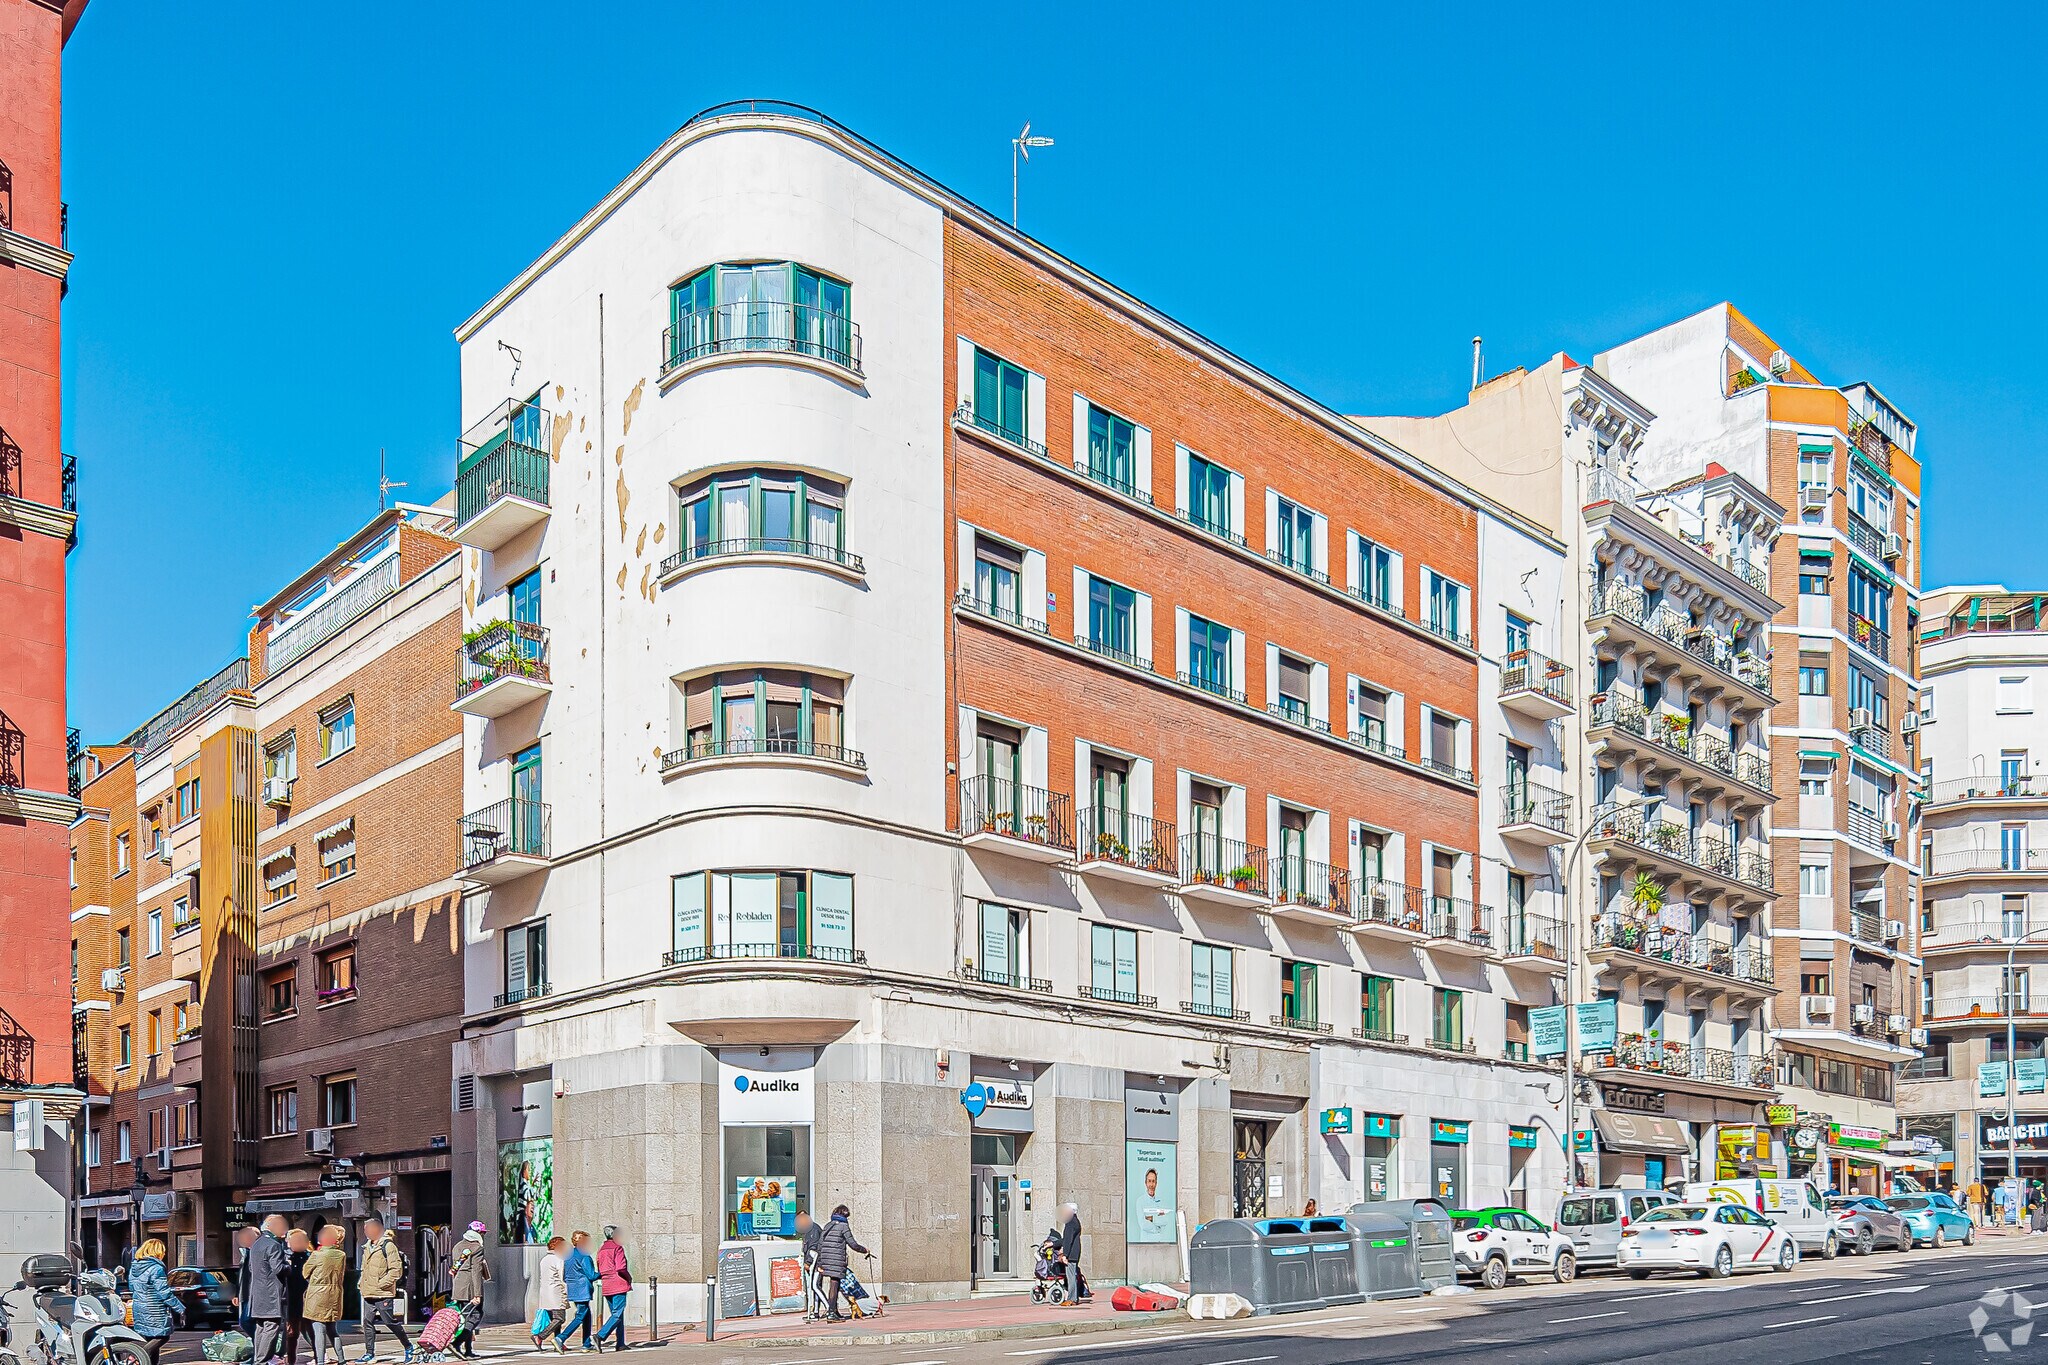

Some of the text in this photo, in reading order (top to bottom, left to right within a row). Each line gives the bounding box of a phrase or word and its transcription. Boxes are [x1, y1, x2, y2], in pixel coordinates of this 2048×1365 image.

[736, 911, 772, 921] Robladen
[816, 906, 850, 916] CLÍNICA DENTAL
[750, 1079, 799, 1092] Audika
[997, 1091, 1027, 1103] Audika
[1987, 1123, 2048, 1142] BASIC-FIT
[1533, 1244, 1549, 1254] ZITY
